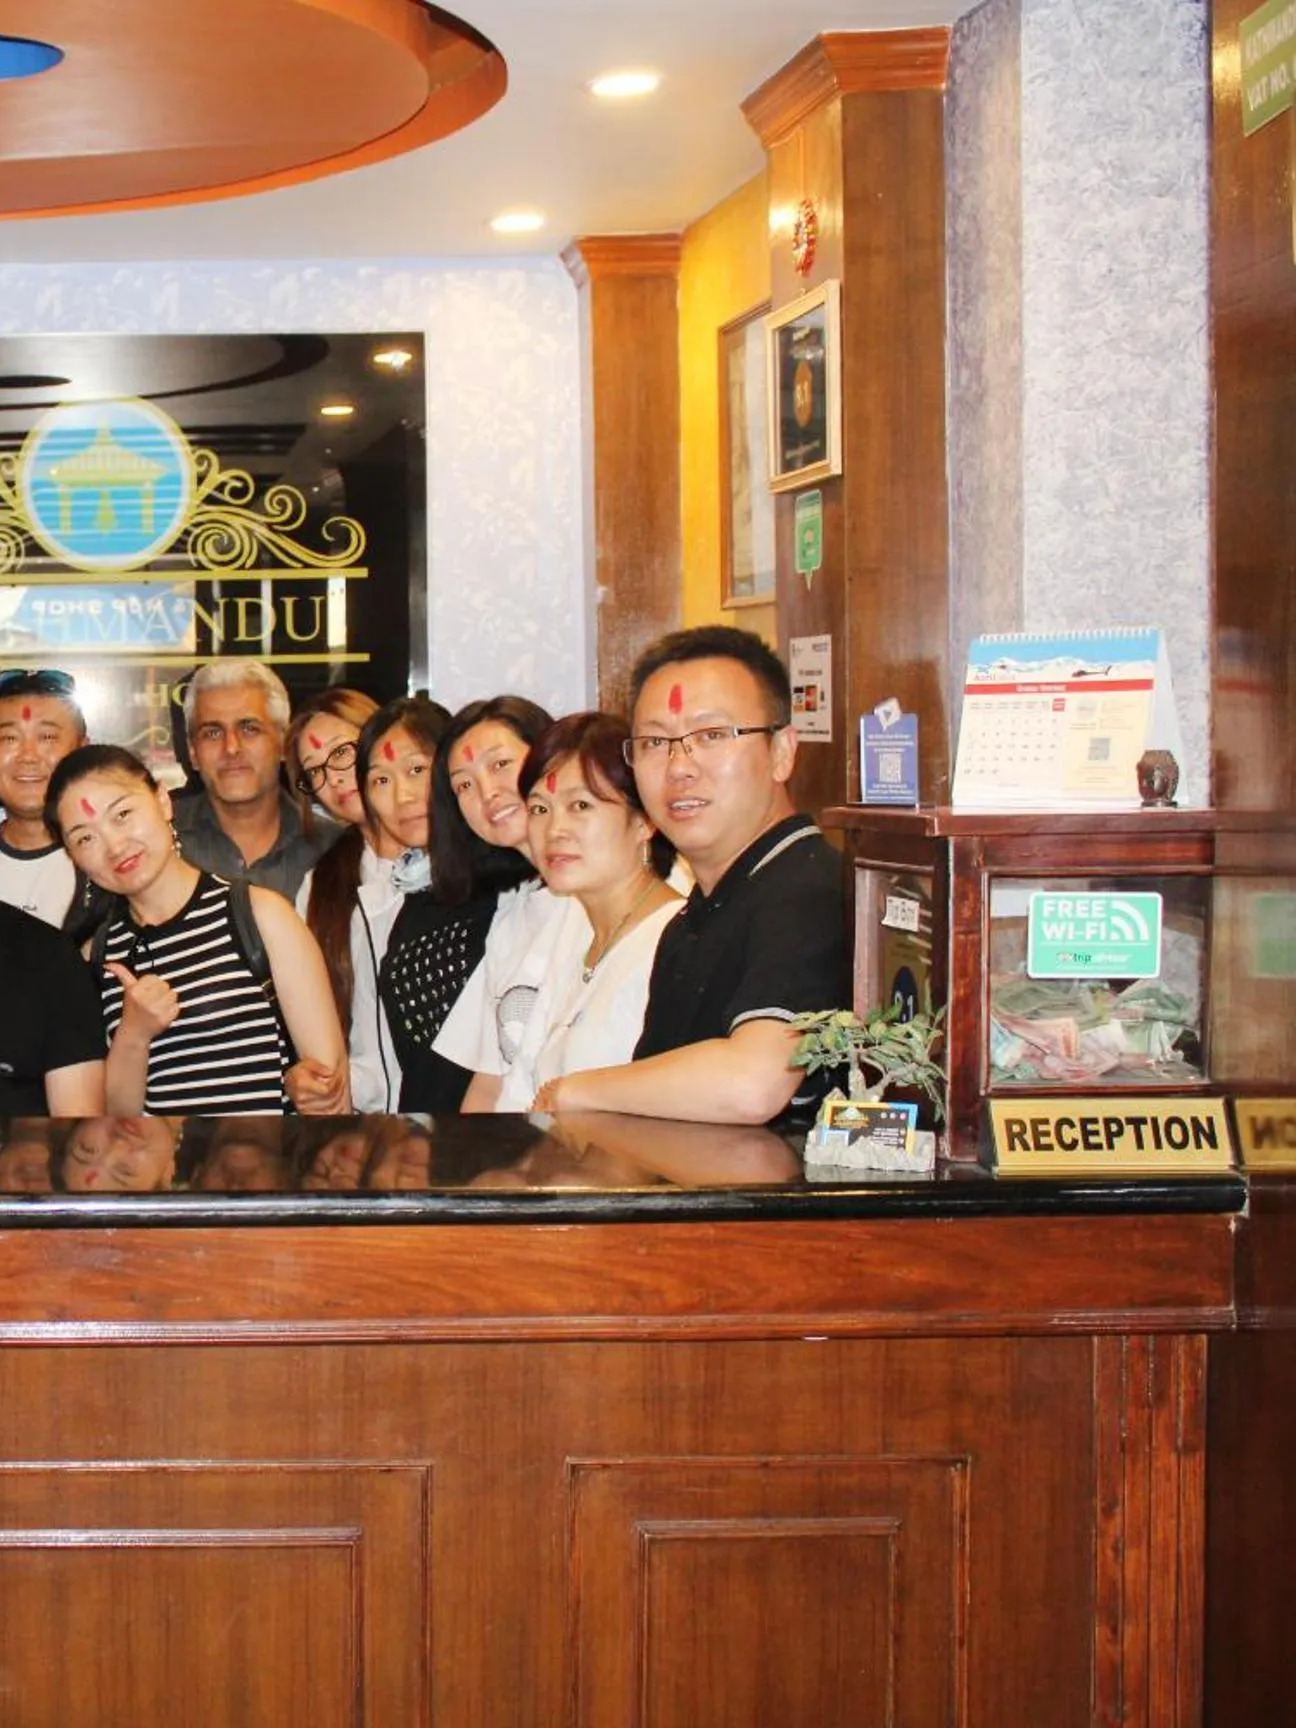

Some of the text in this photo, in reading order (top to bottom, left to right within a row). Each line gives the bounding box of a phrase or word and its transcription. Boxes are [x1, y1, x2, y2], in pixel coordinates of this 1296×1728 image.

[1044, 899, 1107, 918] FREE
[1042, 921, 1107, 940] WI-FI
[1004, 1115, 1219, 1151] RECEPTION
